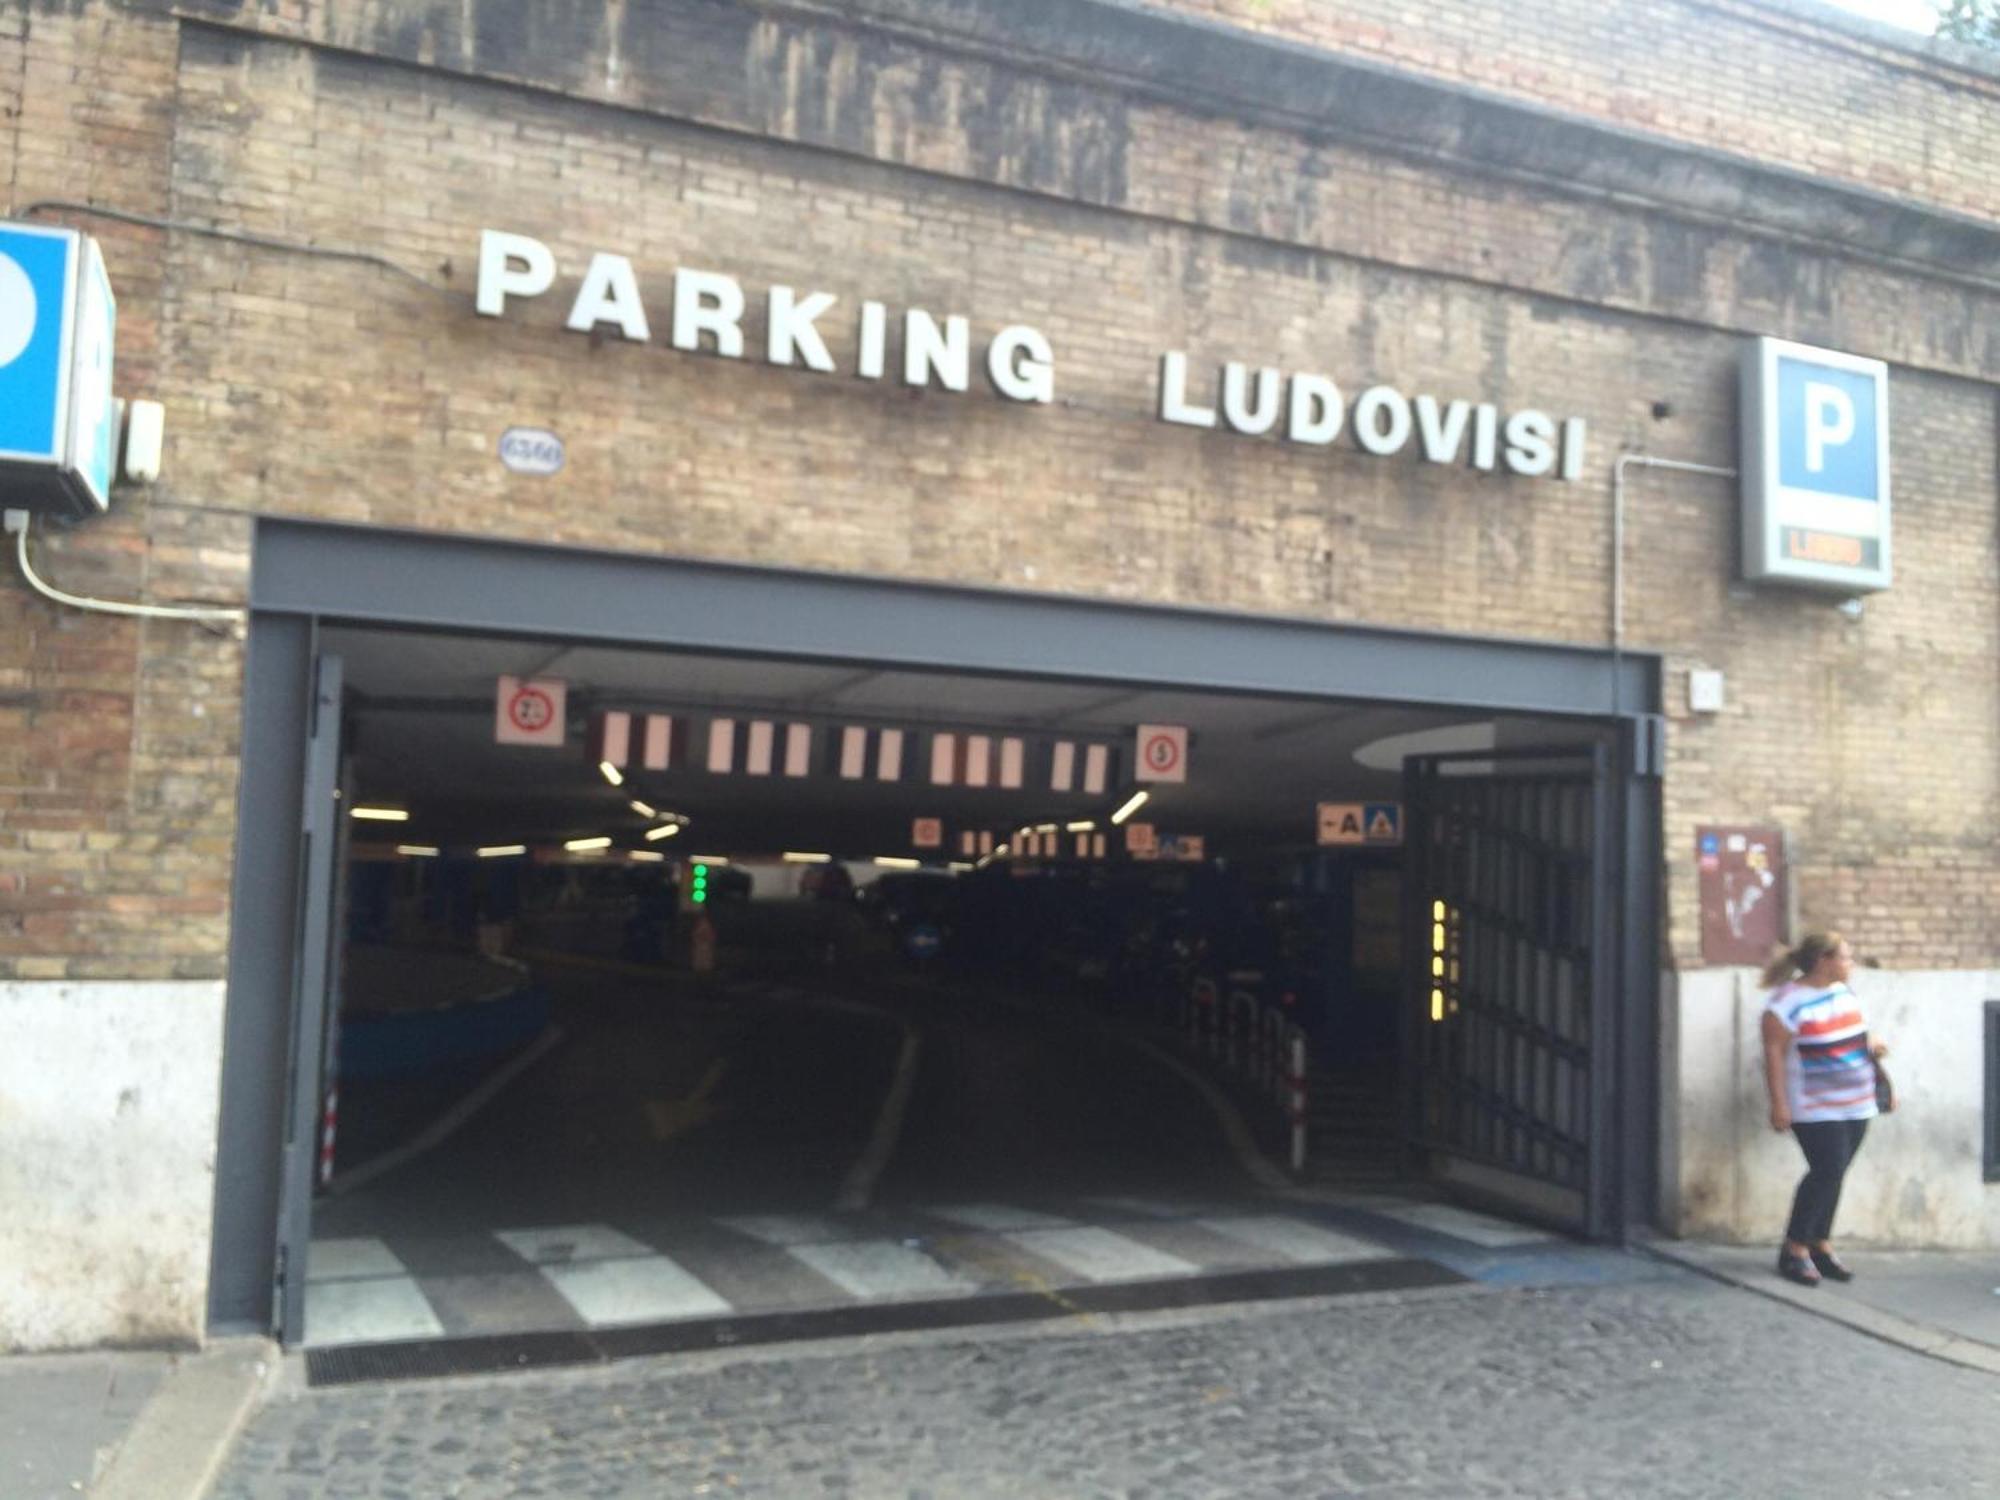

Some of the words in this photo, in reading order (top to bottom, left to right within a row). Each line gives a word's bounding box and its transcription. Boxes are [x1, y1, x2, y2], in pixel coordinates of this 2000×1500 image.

[476, 229, 1054, 404] PARKING
[1160, 351, 1587, 481] LUDOVISI
[1804, 381, 1856, 473] P
[1341, 812, 1360, 835] A
